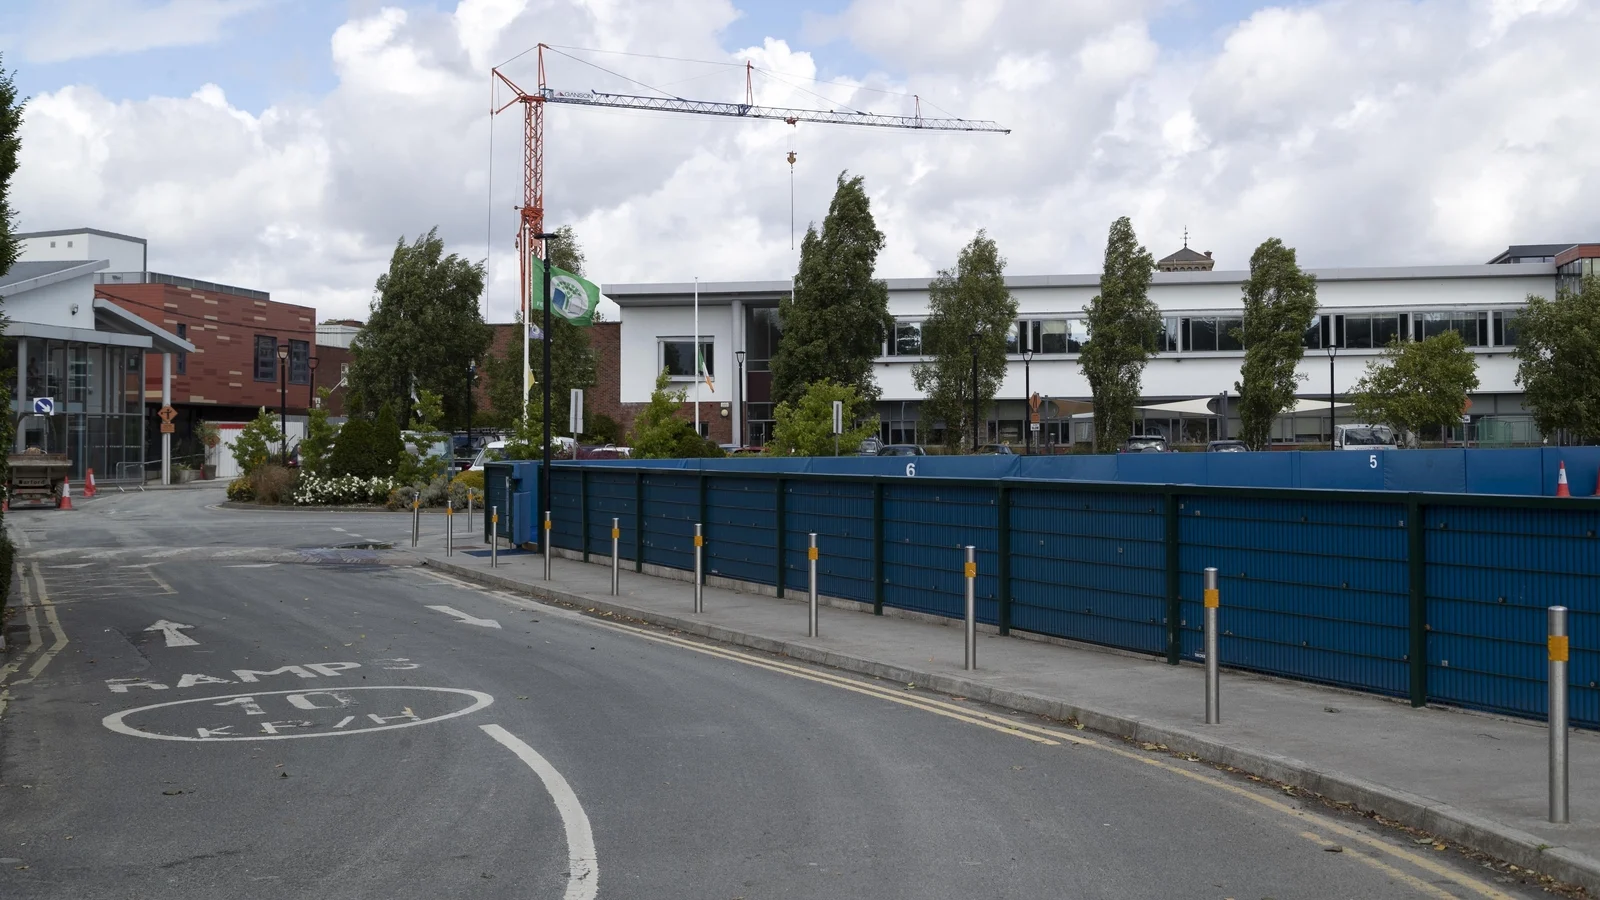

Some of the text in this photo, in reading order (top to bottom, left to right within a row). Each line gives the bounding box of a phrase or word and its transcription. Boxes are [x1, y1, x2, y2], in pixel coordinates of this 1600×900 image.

[1369, 454, 1378, 469] 5
[906, 462, 916, 477] 6
[213, 691, 356, 715] 10
